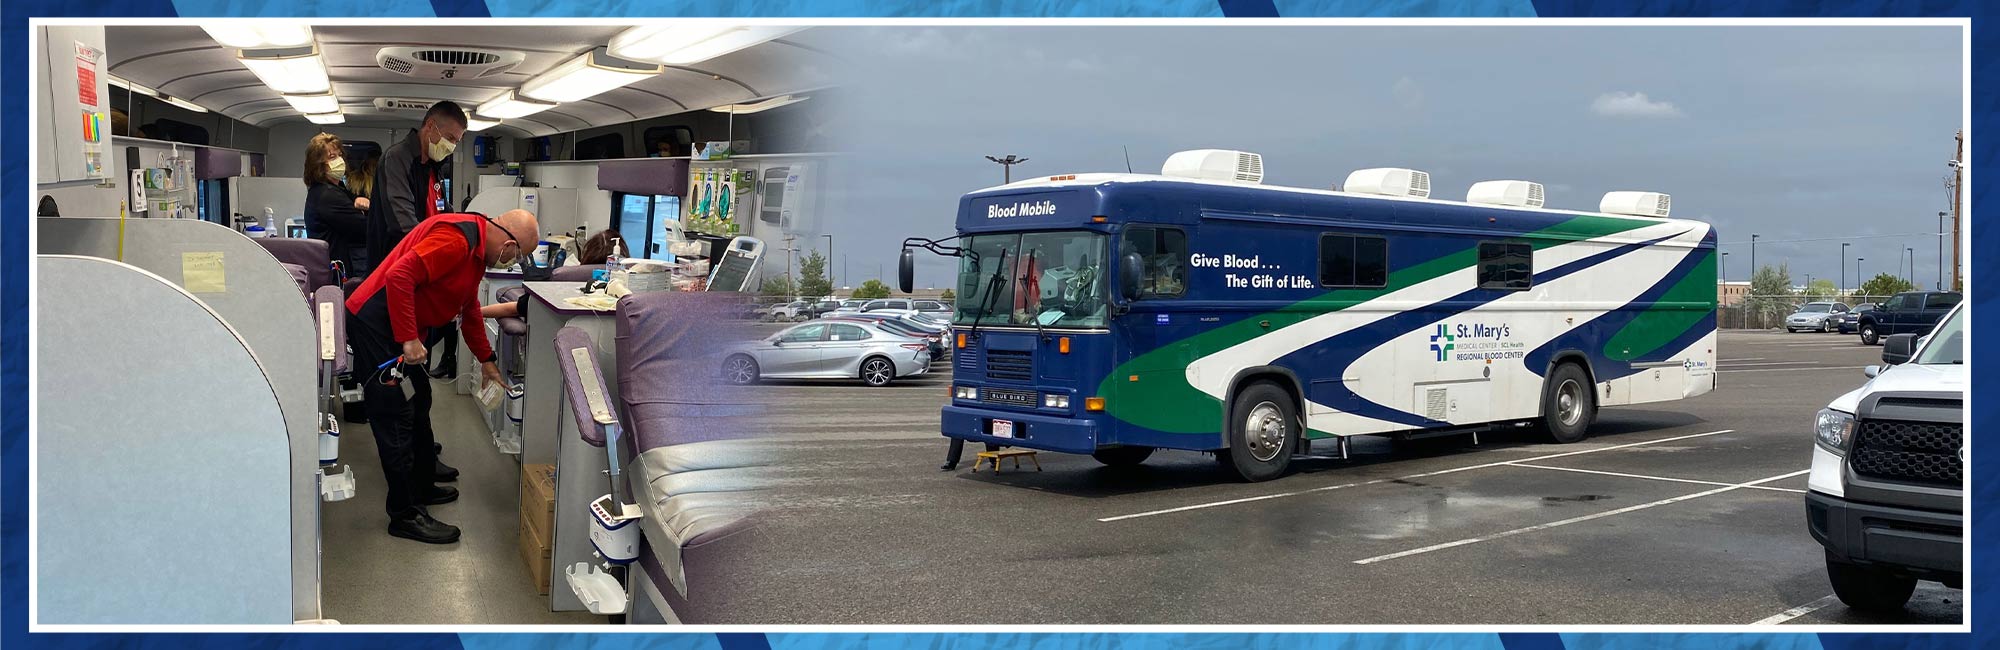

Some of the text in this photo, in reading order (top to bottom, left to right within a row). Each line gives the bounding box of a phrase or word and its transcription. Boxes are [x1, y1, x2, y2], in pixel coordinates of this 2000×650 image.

[988, 200, 1056, 218] Blood Mobile
[1190, 253, 1220, 267] Give
[1223, 254, 1259, 268] Blood
[1225, 274, 1315, 289] The Gift of Life.
[1456, 323, 1510, 340] St. Mary's
[1456, 351, 1524, 361] REGIONAL BLOOD CENTER
